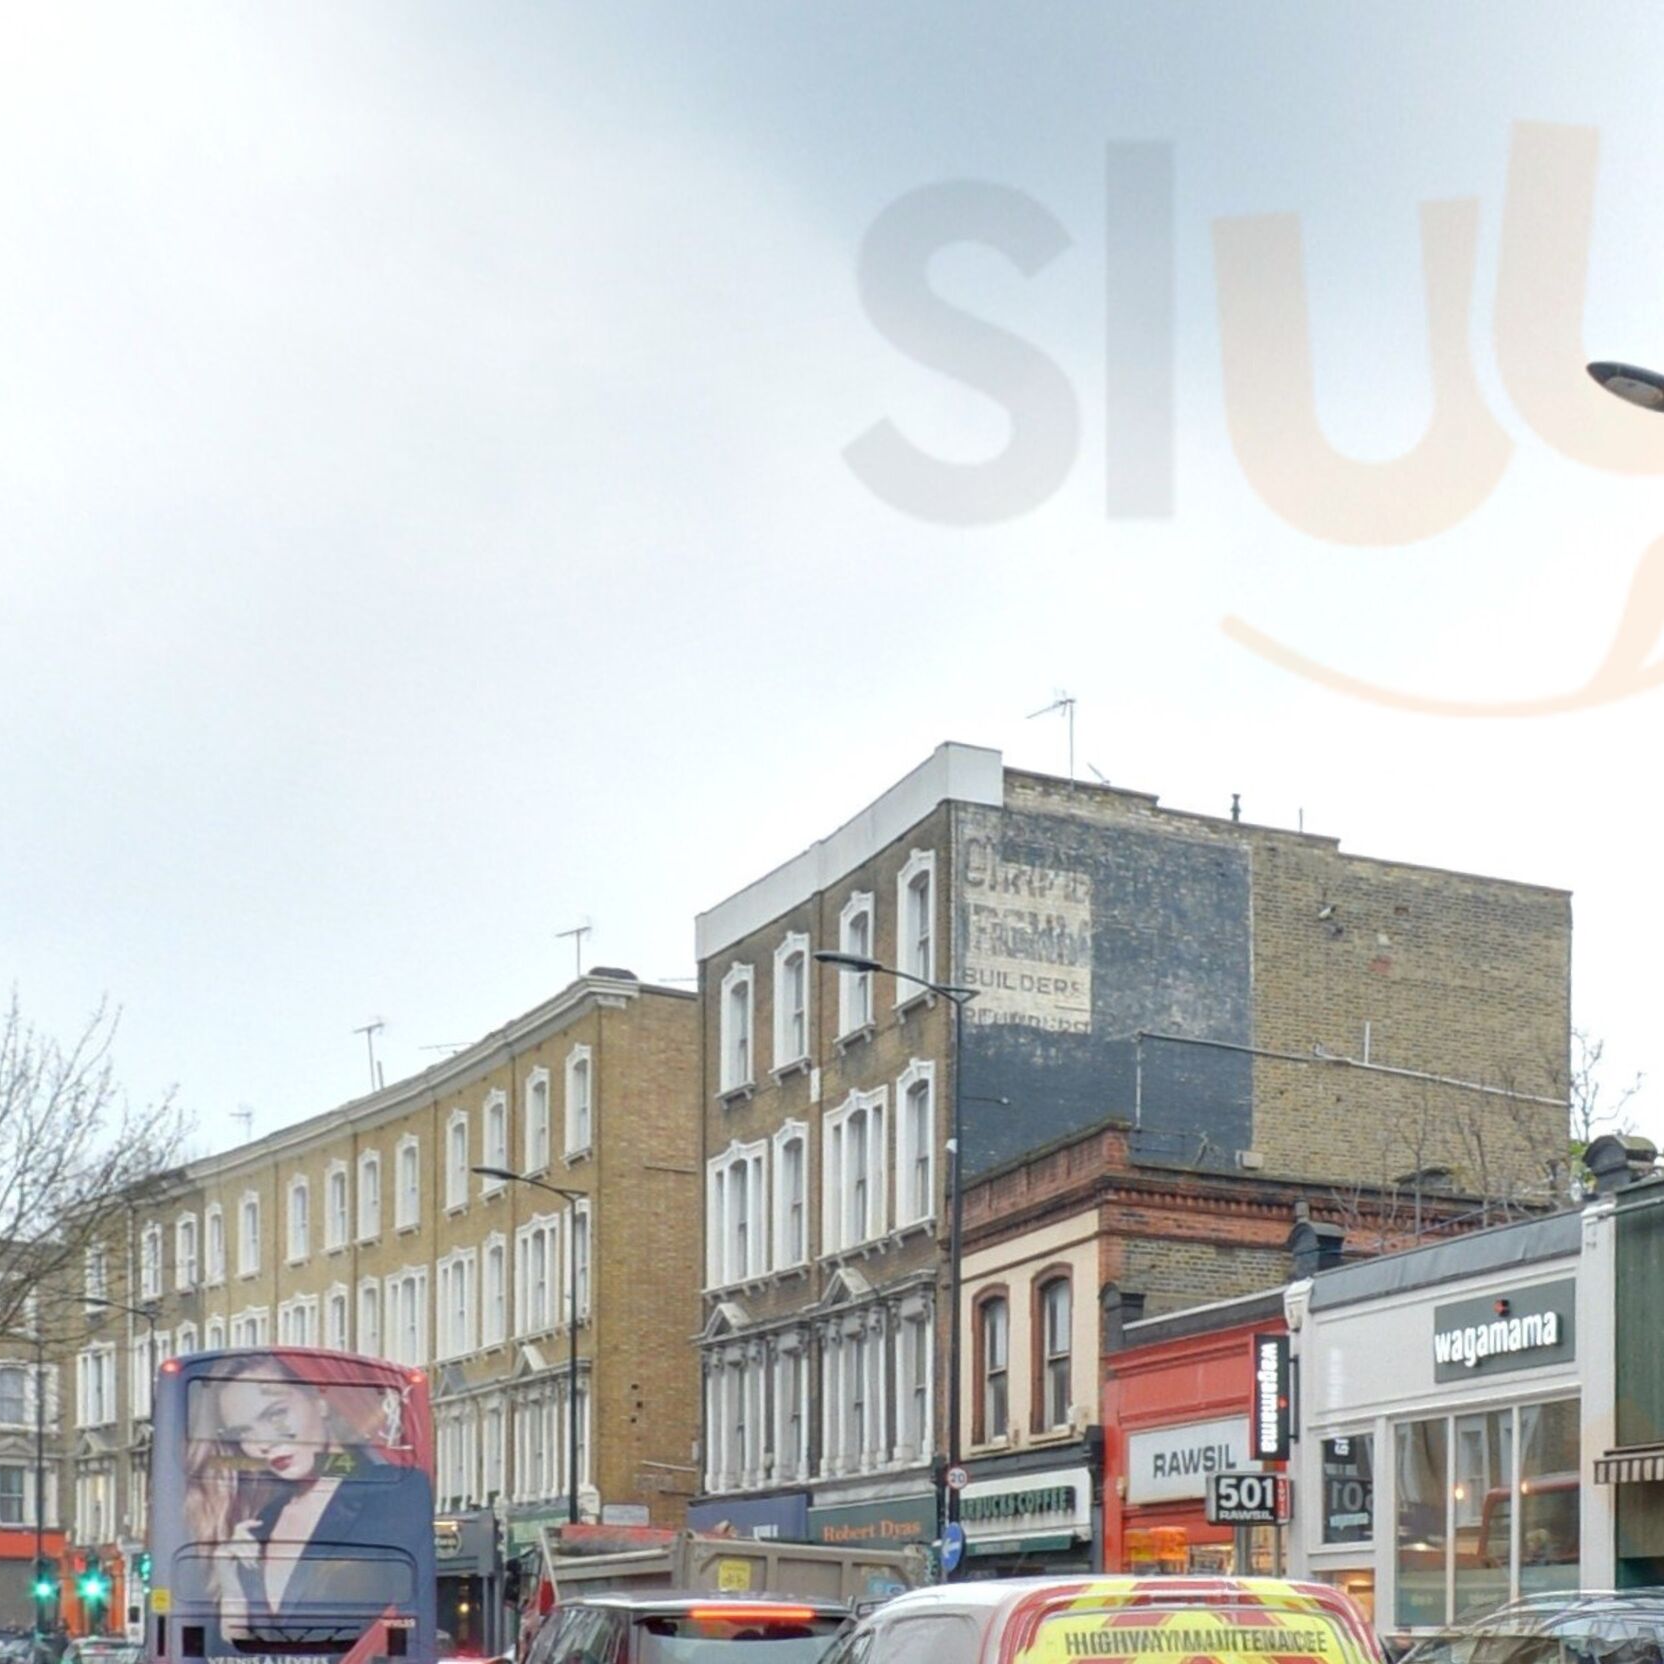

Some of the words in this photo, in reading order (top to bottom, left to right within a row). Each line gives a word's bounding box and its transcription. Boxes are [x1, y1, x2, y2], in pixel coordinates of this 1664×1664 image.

[962, 966, 1085, 998] BUILDERS
[1434, 1310, 1558, 1368] wagamama
[1257, 1341, 1278, 1453] wagamama
[1152, 1443, 1237, 1479] RAWSIL
[1017, 1485, 1069, 1514] COFFEE
[1218, 1476, 1275, 1509] 501
[1218, 1509, 1275, 1521] RAWSIL
[822, 1524, 876, 1543] Robert
[879, 1520, 922, 1538] Dyas
